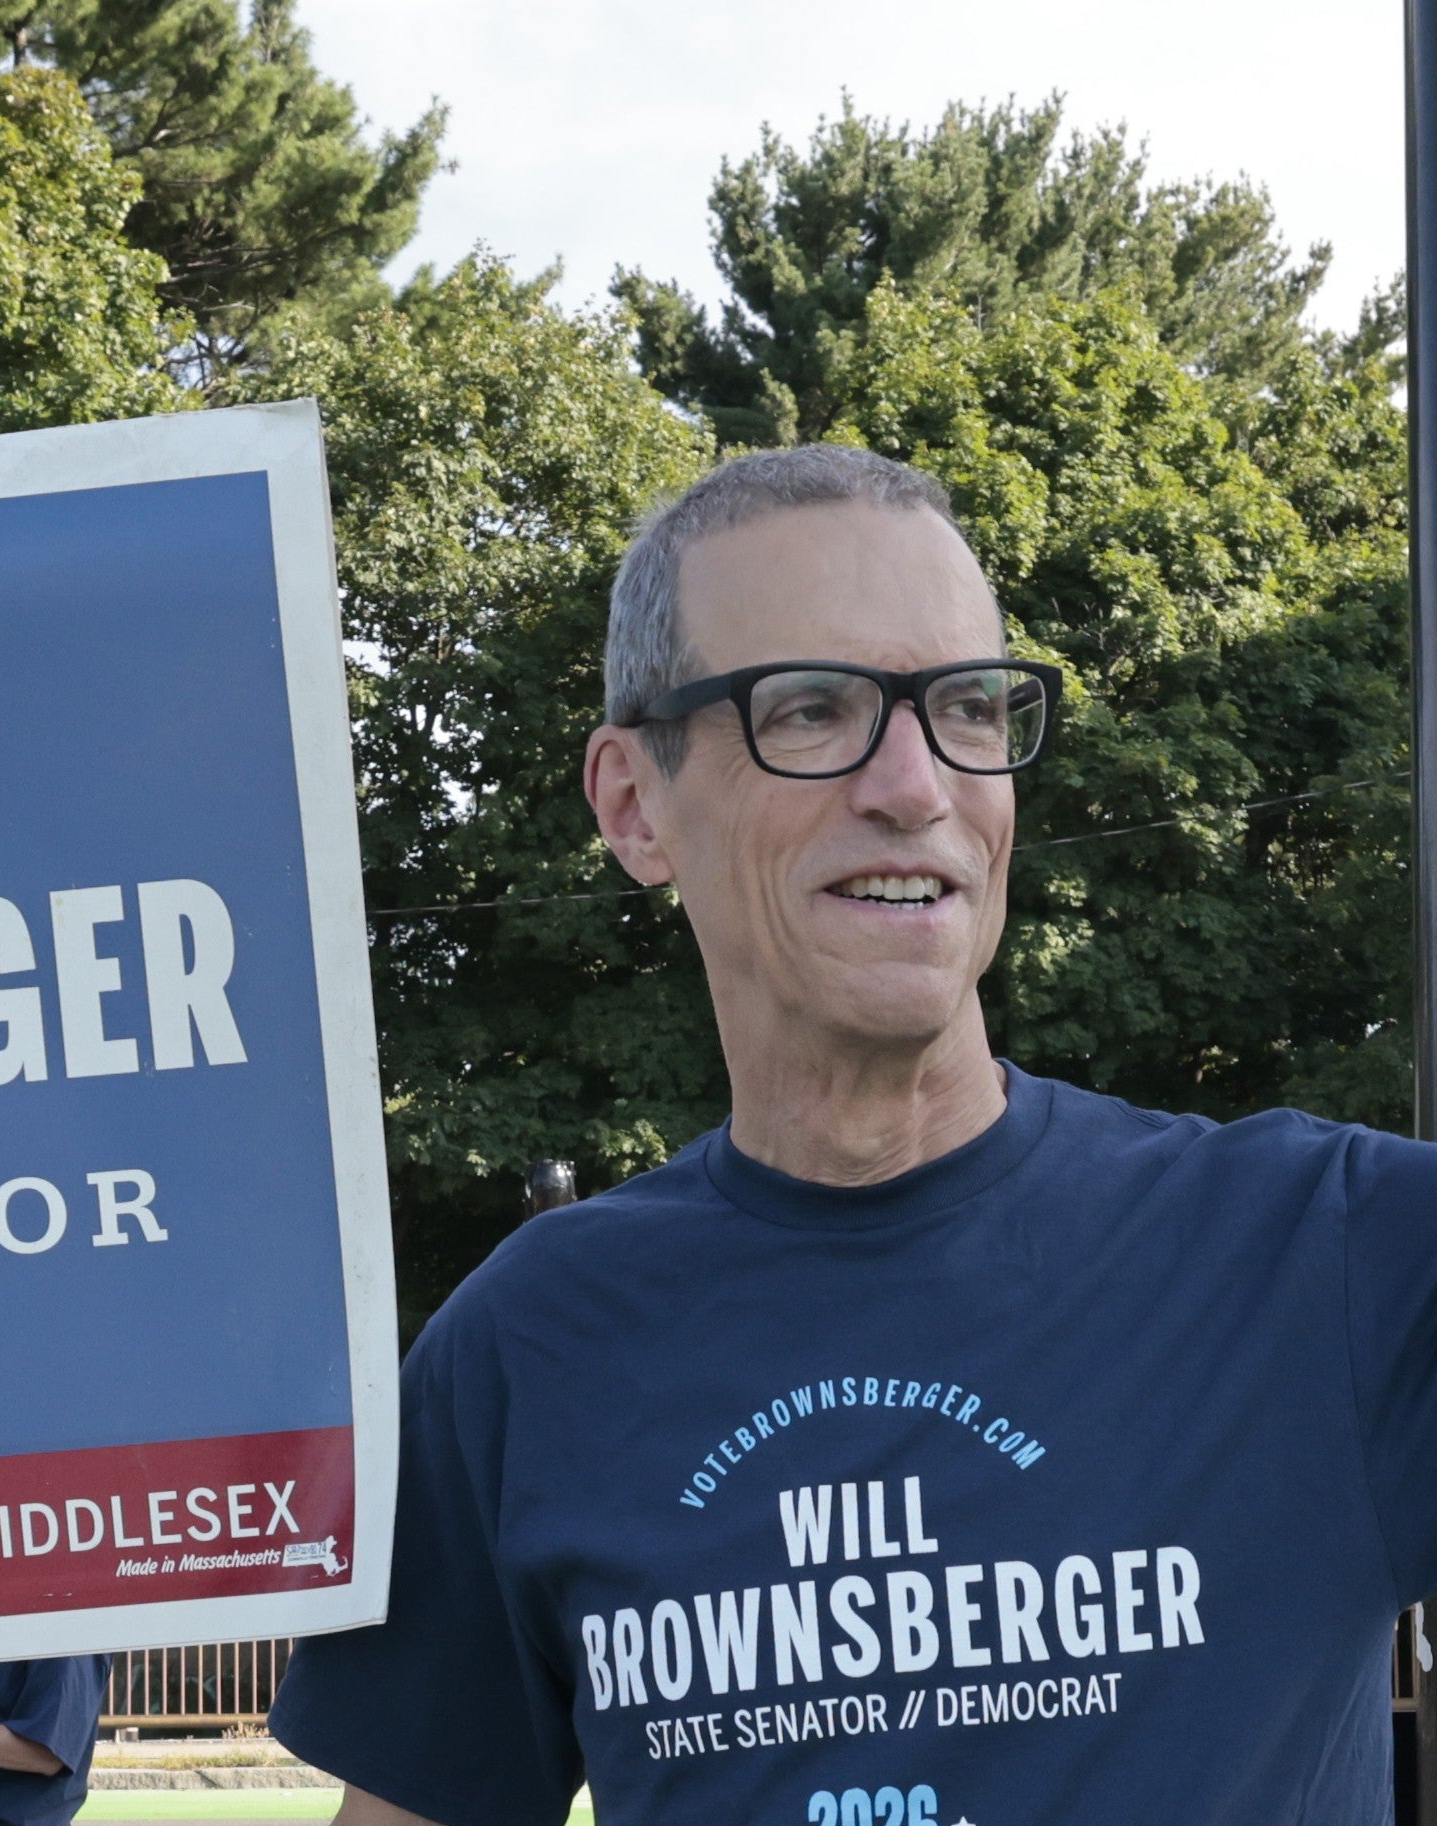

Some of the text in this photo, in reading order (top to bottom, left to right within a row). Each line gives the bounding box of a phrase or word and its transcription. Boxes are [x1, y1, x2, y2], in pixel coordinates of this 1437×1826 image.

[679, 1376, 1046, 1510] VOTEBROWNSBERGER.COM
[116, 1559, 157, 1577] Made
[161, 1556, 174, 1573] in
[178, 1549, 281, 1571] Massachusetts
[780, 1476, 939, 1567] WILL
[581, 1545, 1205, 1710] BROWNSBERGER
[645, 1711, 729, 1760] STATE
[737, 1694, 888, 1749] SENATOR
[938, 1672, 1122, 1727] DEMOCRAT
